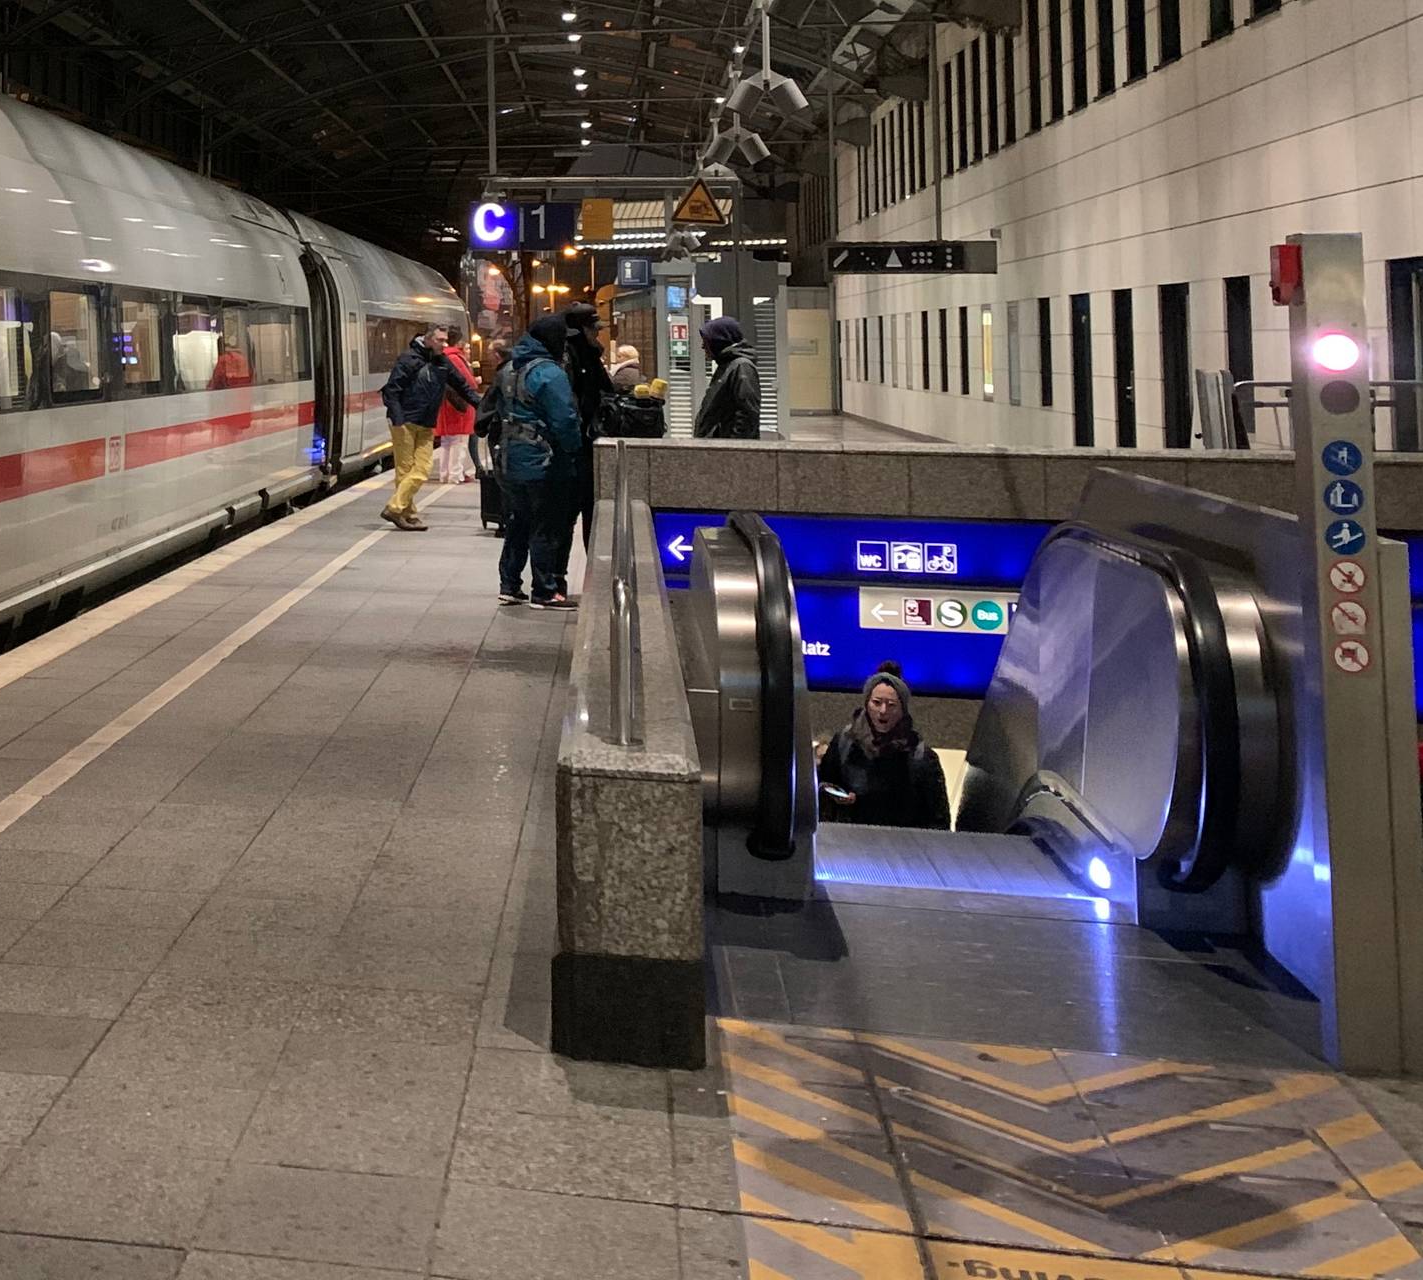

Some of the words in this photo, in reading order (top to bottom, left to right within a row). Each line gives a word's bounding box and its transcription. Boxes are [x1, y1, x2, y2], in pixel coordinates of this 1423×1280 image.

[474, 203, 505, 241] C
[531, 205, 545, 239] 1
[859, 554, 882, 568] WC
[940, 600, 964, 627] S
[977, 609, 999, 621] Bus
[801, 640, 831, 656] latz
